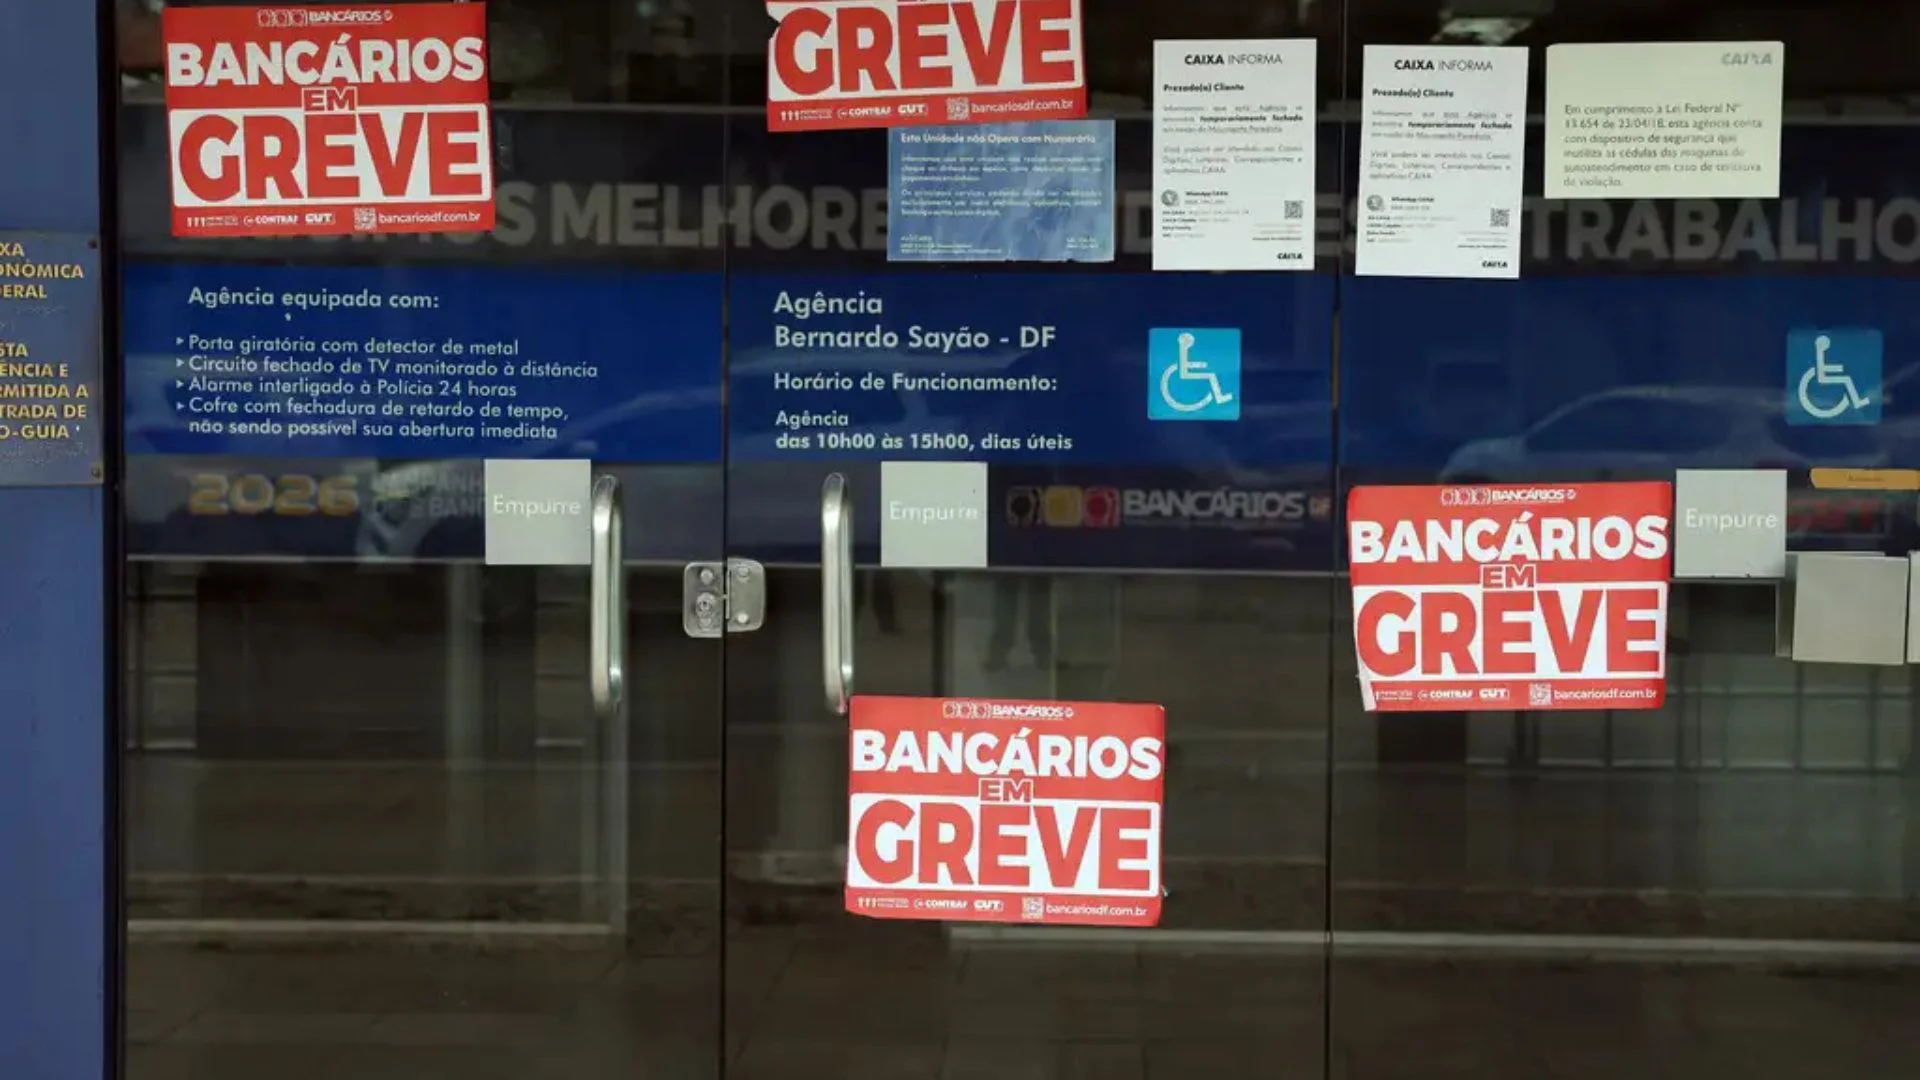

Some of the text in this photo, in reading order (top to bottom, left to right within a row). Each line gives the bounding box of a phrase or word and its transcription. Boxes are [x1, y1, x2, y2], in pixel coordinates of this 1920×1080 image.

[308, 9, 381, 23] BANCÁRIOS
[775, 0, 1075, 95] GREVE
[167, 33, 485, 87] BANCÁRIOS
[1184, 54, 1282, 65] CAIXA INFORMA
[1394, 60, 1493, 71] CAIXA INFORMA
[1213, 84, 1244, 92] Cliente
[1423, 89, 1454, 98] Cliente
[303, 88, 356, 111] EM
[971, 99, 1073, 113] bancariosdf.com.br
[1564, 105, 1581, 114] Em
[1584, 105, 1653, 116] cumprimento
[1665, 104, 1681, 113] Lei
[1684, 103, 1722, 113] Federal
[1602, 119, 1615, 129] de
[1668, 120, 1689, 129] esta
[1692, 119, 1730, 131] agência
[1733, 120, 1763, 129] conta
[901, 134, 921, 143] Esta
[923, 133, 965, 143] Unidade
[967, 133, 987, 143] não
[988, 134, 1019, 145] Opera
[1044, 133, 1096, 143] Numerário
[1564, 135, 1587, 143] com
[1589, 134, 1645, 146] dispositivo
[1648, 133, 1661, 143] de
[179, 112, 483, 201] GREVE
[1619, 148, 1657, 159] cédulas
[1660, 148, 1677, 158] das
[1654, 164, 1671, 173] em
[1700, 163, 1713, 173] de
[378, 212, 480, 225] bancariosdf.com.br
[0, 284, 48, 299] ERAL
[188, 287, 440, 311] Agência equipada com:
[773, 291, 883, 319] Agência
[188, 335, 519, 355] Porta giratória com detector de metal
[774, 324, 899, 348] Bernardo
[908, 326, 989, 353] Sayão
[1019, 326, 1057, 348] DF
[188, 355, 598, 378] Circuito fechado de TV monitorado à distância
[0, 384, 89, 398] MITIDA A
[188, 376, 517, 397] Alarme interligado à Polícia 24 horas
[773, 372, 1058, 392] Horário de Funcionamento:
[63, 404, 87, 419] DE
[188, 397, 569, 422] Cofre com fechadura de retardo de tempo,
[775, 410, 849, 429] Agência
[188, 419, 558, 439] não sendo possível sua abertura imediata
[775, 433, 1073, 452] das 10h00 às 15h00, dias úteis
[188, 473, 358, 516] 2026
[1123, 487, 1305, 519] BANCÁRIOS
[493, 495, 581, 519] Empurre
[890, 501, 978, 525] Empurre
[1685, 507, 1778, 532] Empurre
[1350, 510, 1668, 563] BANCÁRIOS
[1482, 565, 1535, 588] EM
[1356, 590, 1660, 677] GREVE
[1553, 689, 1656, 701] bancariosdf.com.br
[852, 728, 1162, 780] BANCÁRIOS
[980, 779, 1033, 801] EM
[855, 800, 1151, 891] GREVE
[1045, 903, 1148, 918] bancariosdf.com.br
